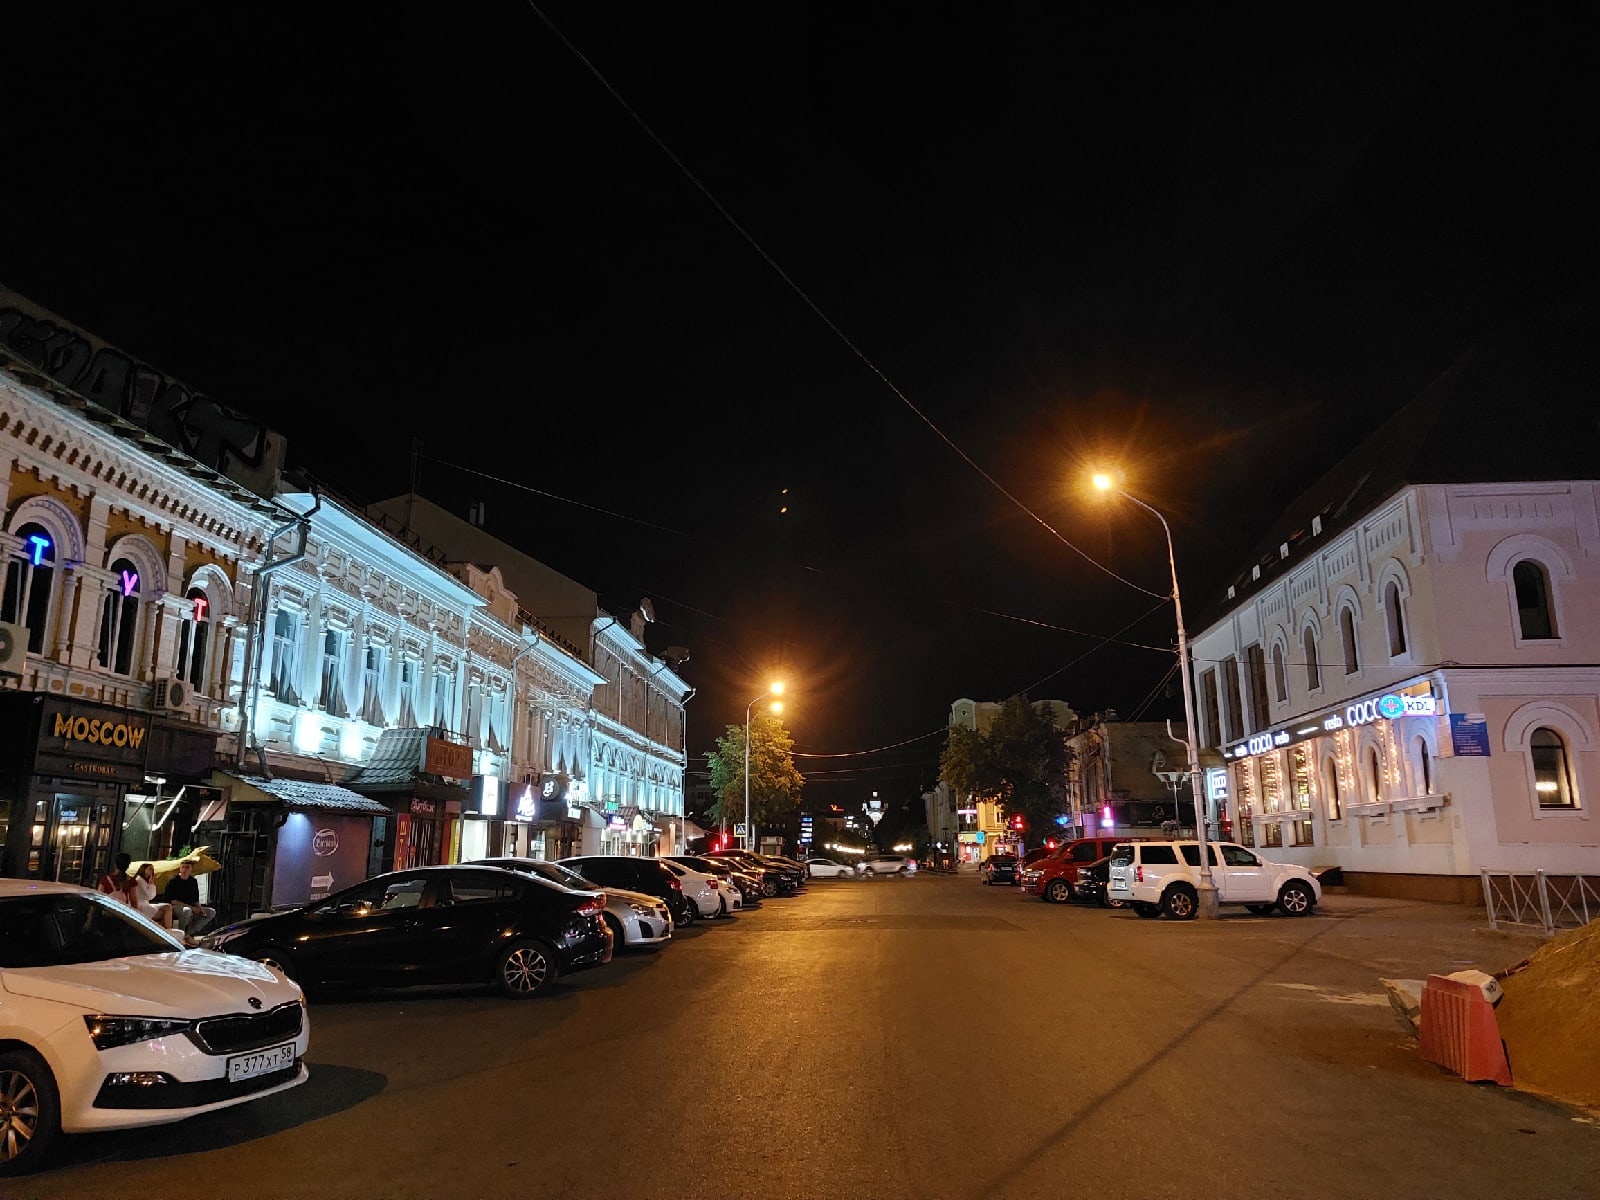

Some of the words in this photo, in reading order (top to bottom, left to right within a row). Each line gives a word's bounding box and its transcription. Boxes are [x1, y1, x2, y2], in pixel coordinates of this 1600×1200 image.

[1406, 701, 1431, 711] KDL
[54, 712, 145, 749] MOSCOW
[1249, 733, 1273, 755] COCO
[74, 762, 115, 775] GASTROBAR
